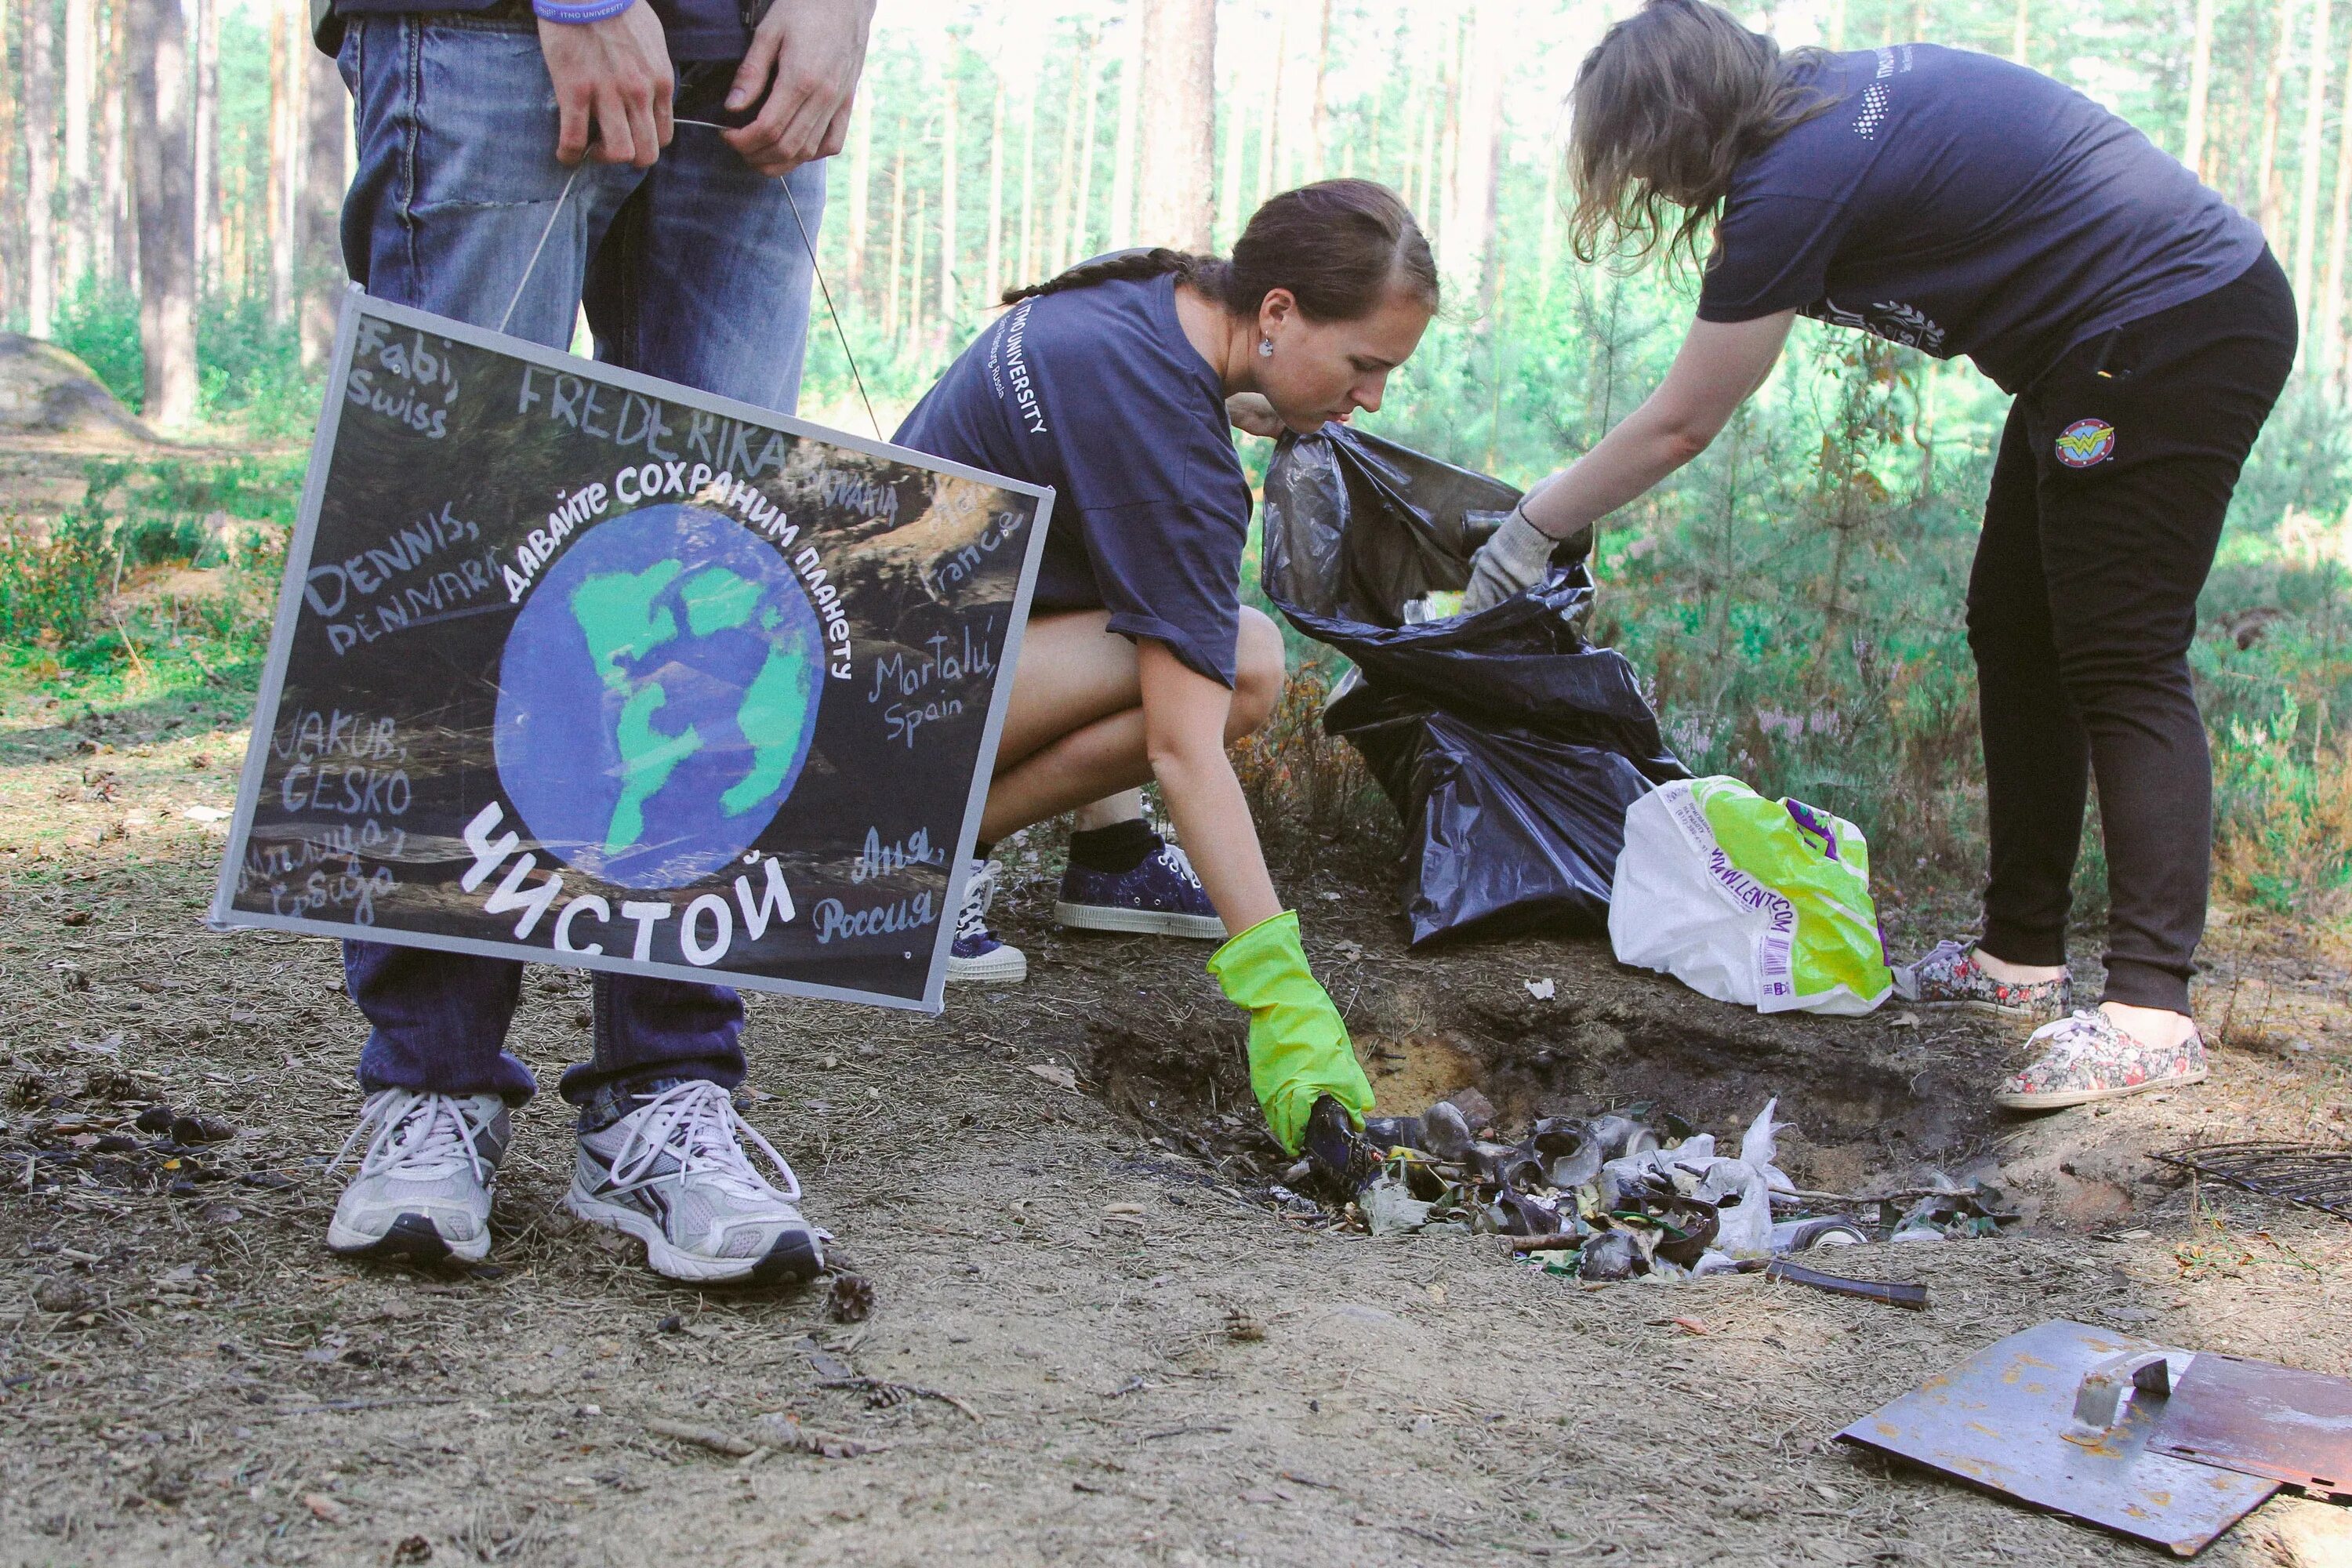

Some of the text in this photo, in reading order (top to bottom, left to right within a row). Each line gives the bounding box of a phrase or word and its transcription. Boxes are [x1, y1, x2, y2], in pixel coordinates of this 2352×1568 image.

[583, 3, 624, 18] UNIVERSITY
[358, 319, 459, 404] Fabi,
[992, 365, 1005, 400] Russia
[1007, 303, 1047, 434] ITMO UNIVERSITY
[347, 368, 448, 440] Swiss
[518, 362, 787, 477] FREDERIKA
[615, 461, 801, 548] СОХРАНИМ
[306, 500, 481, 618] DENNIS,
[326, 546, 503, 655] DENMARK
[884, 688, 964, 748] Spain
[281, 753, 412, 815] ČESKO
[461, 800, 797, 967] ЧИСТОЙ
[850, 825, 946, 885] Аня,
[812, 887, 938, 945] Россия
